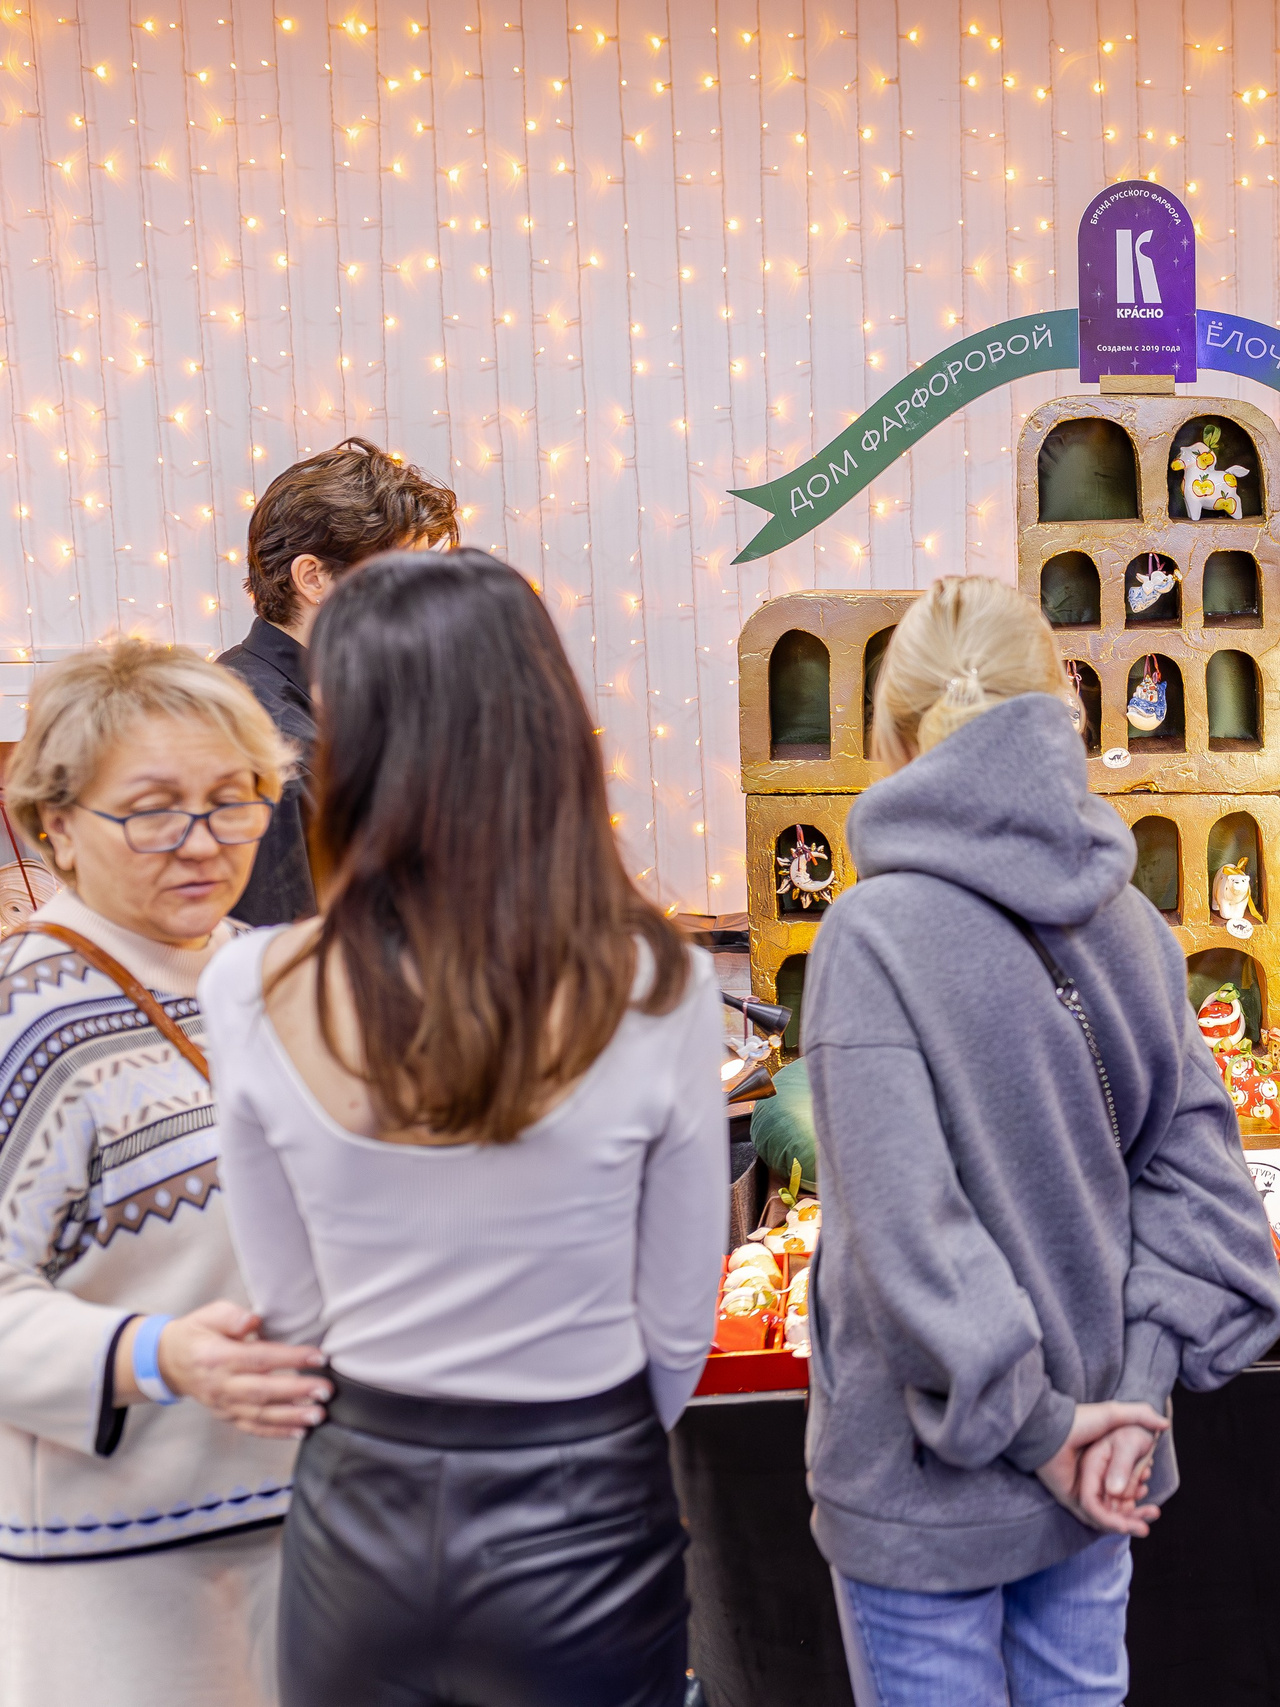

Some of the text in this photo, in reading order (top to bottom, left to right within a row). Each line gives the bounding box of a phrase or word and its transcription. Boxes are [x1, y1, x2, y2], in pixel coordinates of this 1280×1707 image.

[1090, 189, 1182, 225] БРЕНД РУССКОГО ФАРФОРА
[1097, 344, 1133, 352] Создаем
[1141, 344, 1160, 353] 2019
[1161, 345, 1181, 353] года
[789, 450, 859, 518] ДОМ
[861, 323, 1053, 452] ФАРФОРОВОЙ
